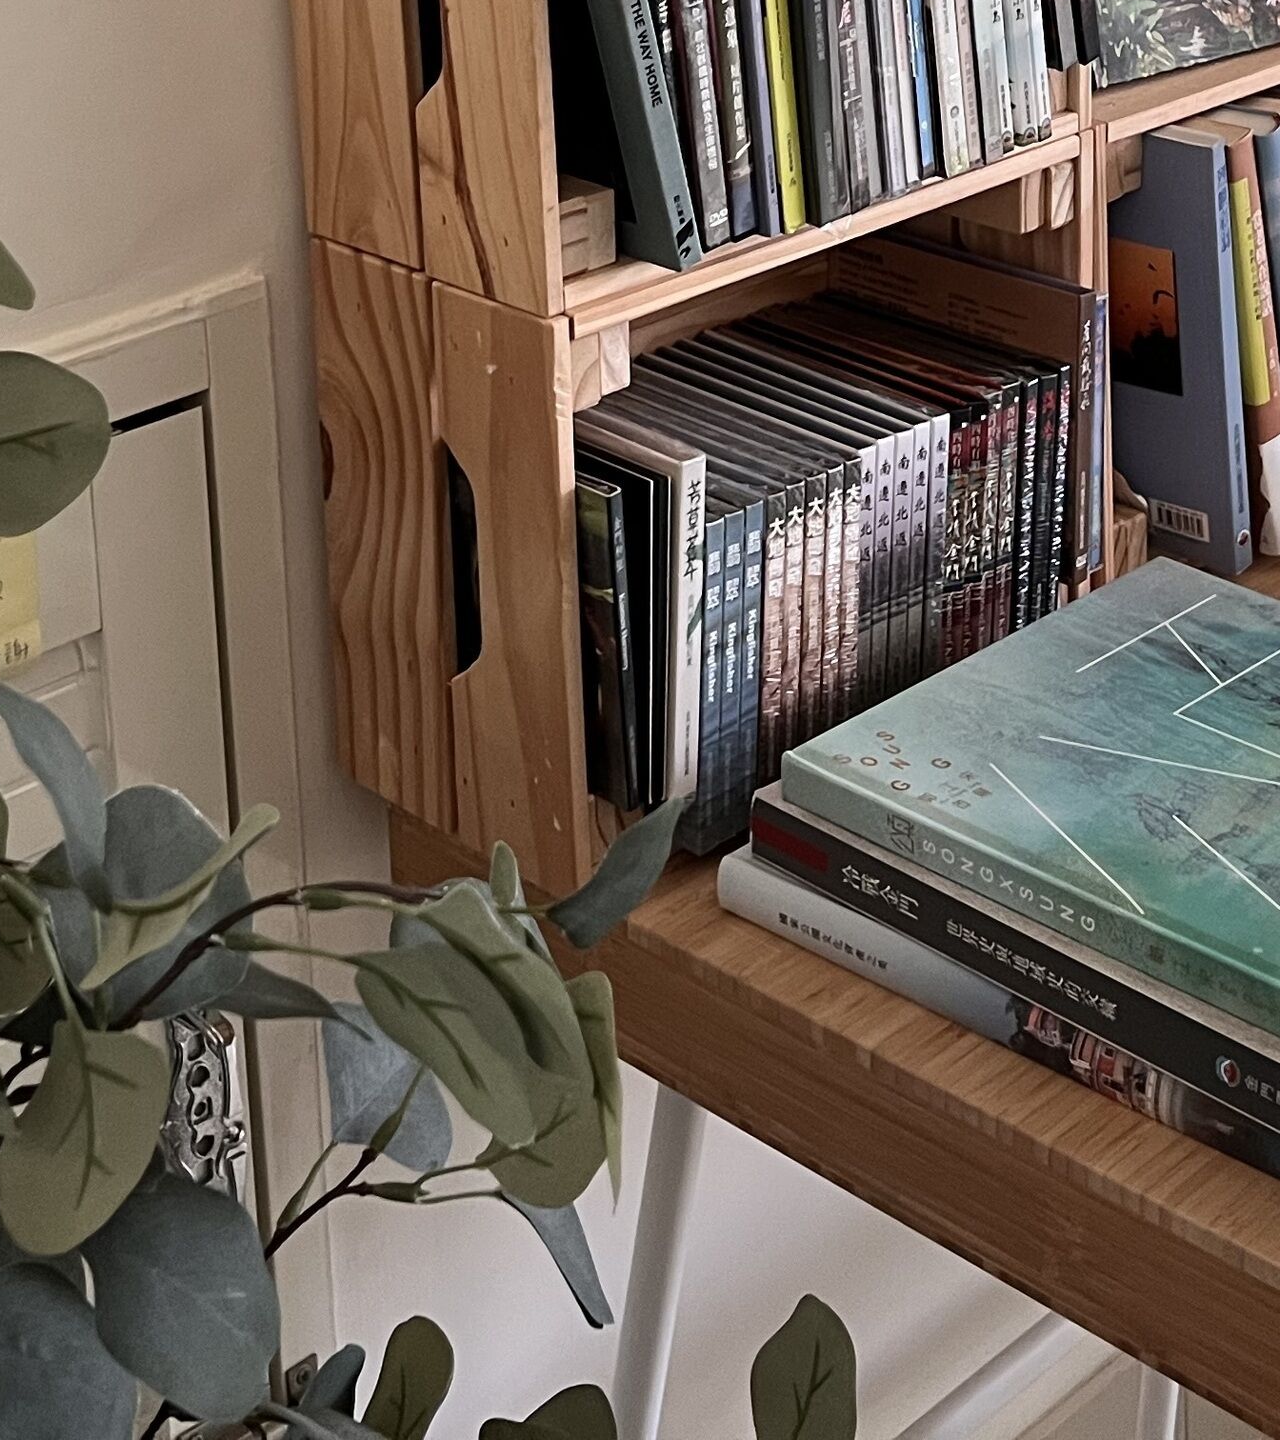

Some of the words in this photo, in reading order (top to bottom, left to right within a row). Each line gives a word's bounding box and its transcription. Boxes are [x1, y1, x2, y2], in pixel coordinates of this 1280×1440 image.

[630, 0, 645, 30] THE
[637, 29, 653, 62] WAY
[645, 63, 663, 109] HOME
[706, 630, 718, 703] Kingfisher
[726, 621, 737, 695] Kingfisher
[746, 609, 758, 680] Kingfisher
[841, 863, 920, 921] 冷戰金門
[944, 918, 1118, 1023] 世界史與地域史的交織
